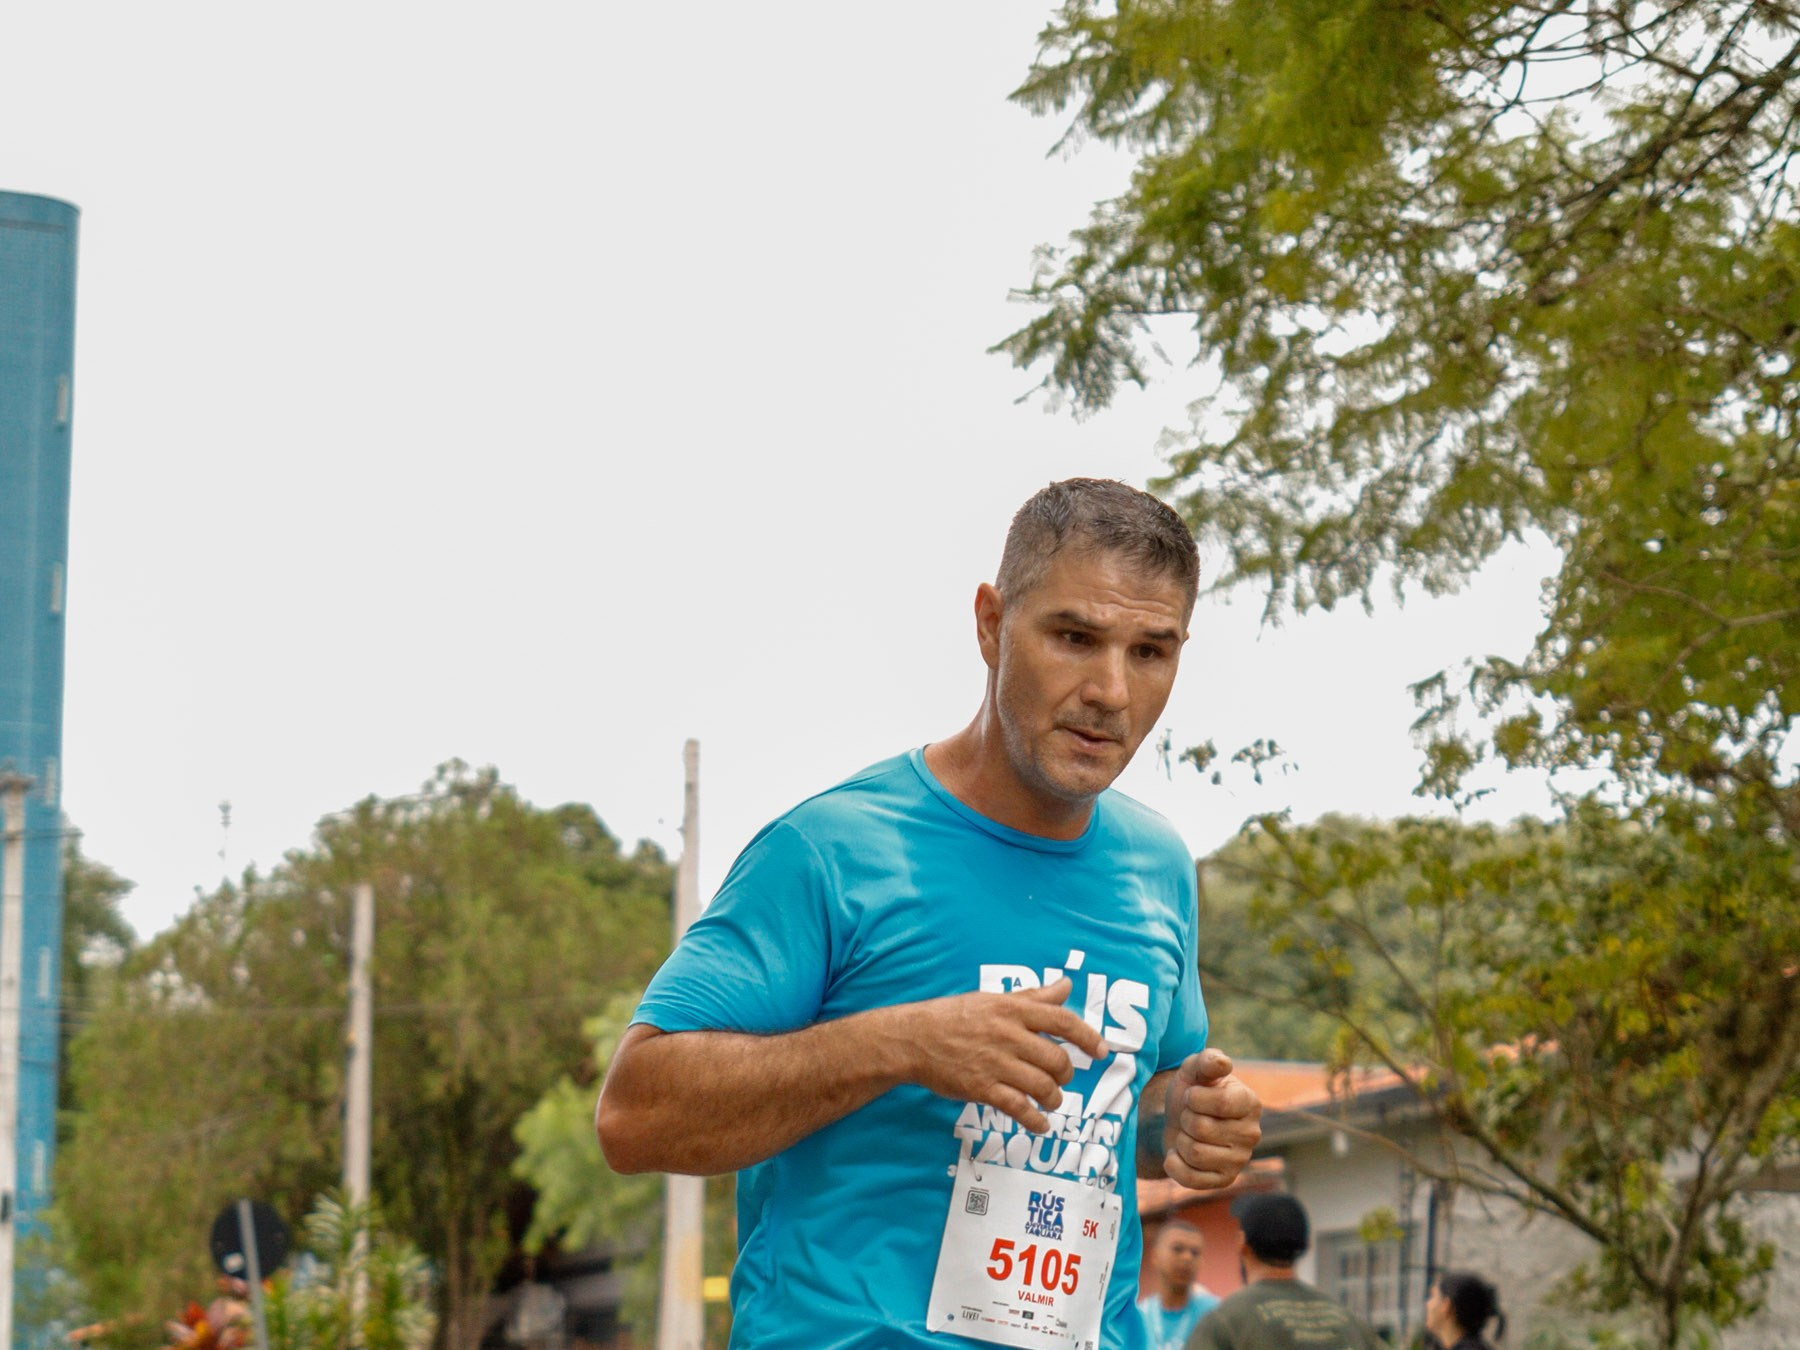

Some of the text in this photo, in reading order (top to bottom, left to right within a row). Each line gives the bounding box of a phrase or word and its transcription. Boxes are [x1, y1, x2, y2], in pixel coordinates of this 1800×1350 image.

[1029, 1190, 1065, 1212] RÚS
[1028, 1206, 1064, 1234] TICA
[1082, 1219, 1099, 1239] 5K
[987, 1238, 1081, 1295] 5105
[1018, 1290, 1054, 1307] VALMIR
